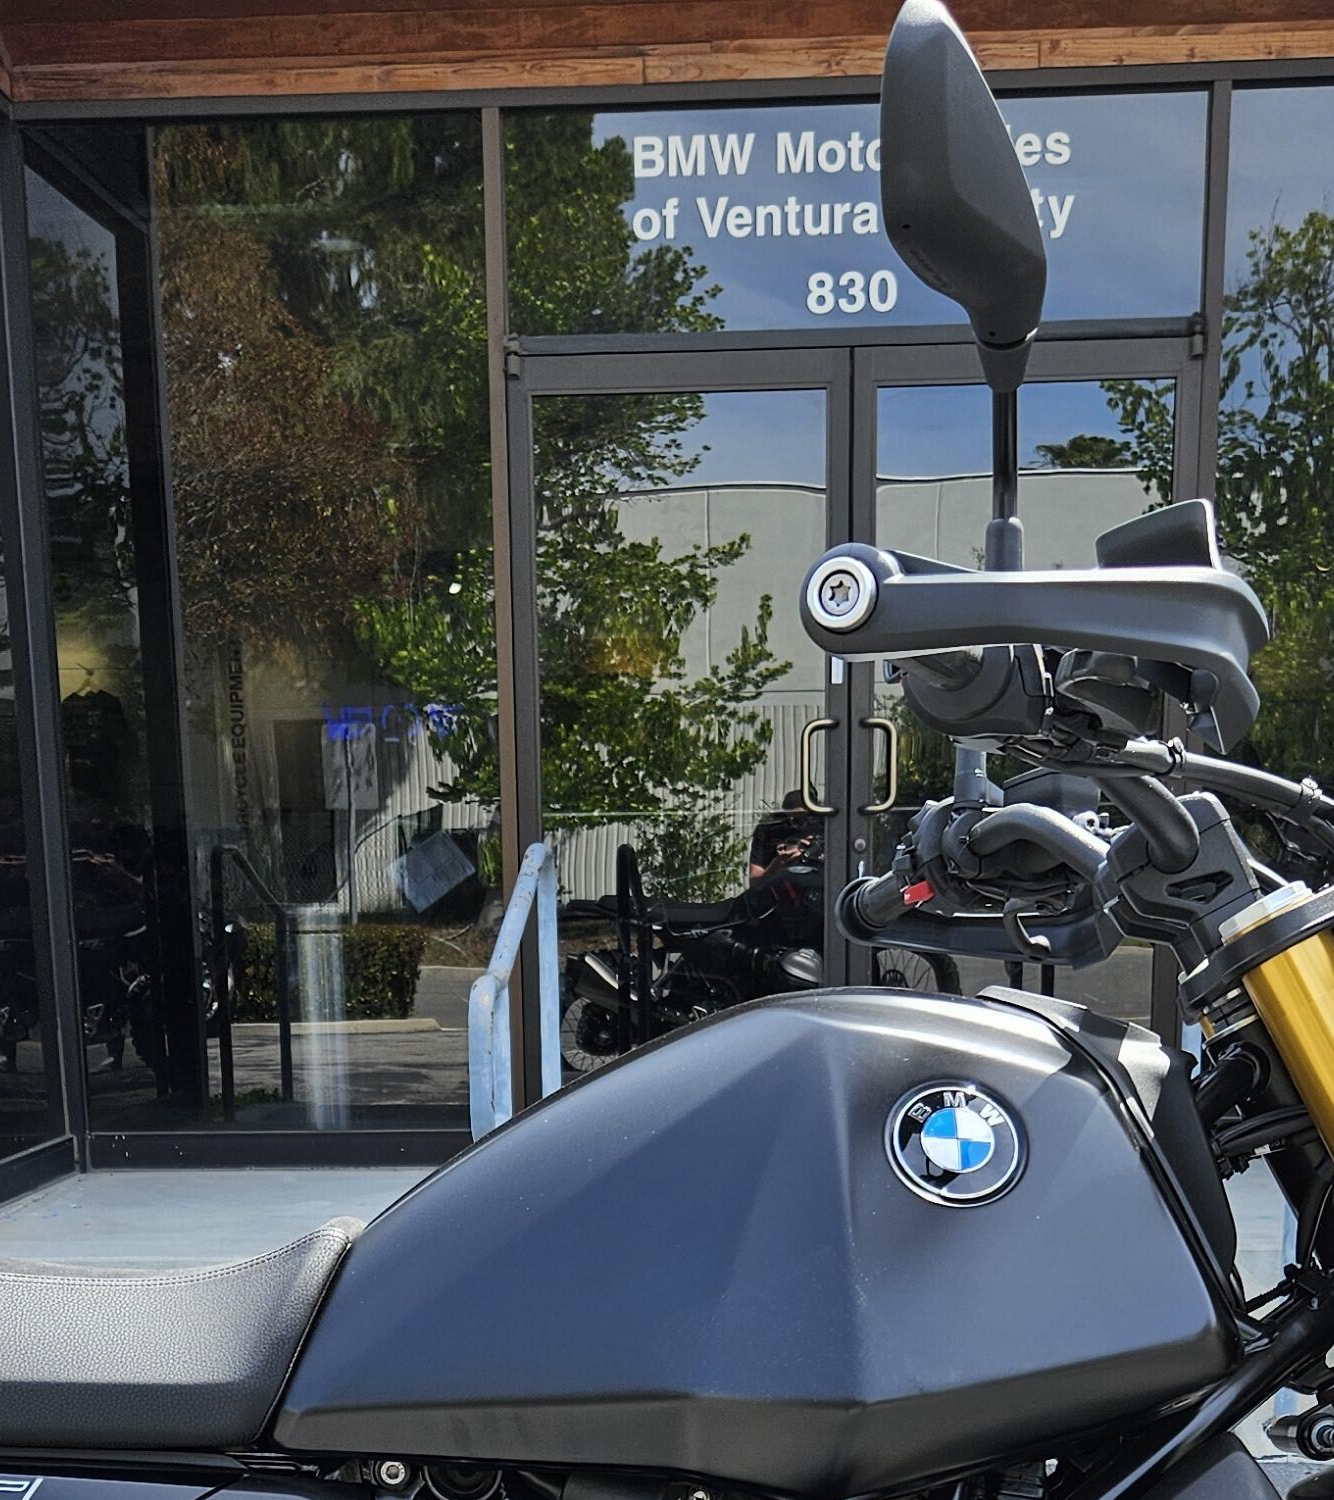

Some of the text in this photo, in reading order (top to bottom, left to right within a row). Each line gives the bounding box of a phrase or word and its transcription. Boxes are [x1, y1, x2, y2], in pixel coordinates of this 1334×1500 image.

[633, 127, 1072, 179] BMW Motoes
[632, 195, 880, 241] of Ventura
[806, 270, 898, 314] 830
[907, 1090, 1005, 1127] BMW
